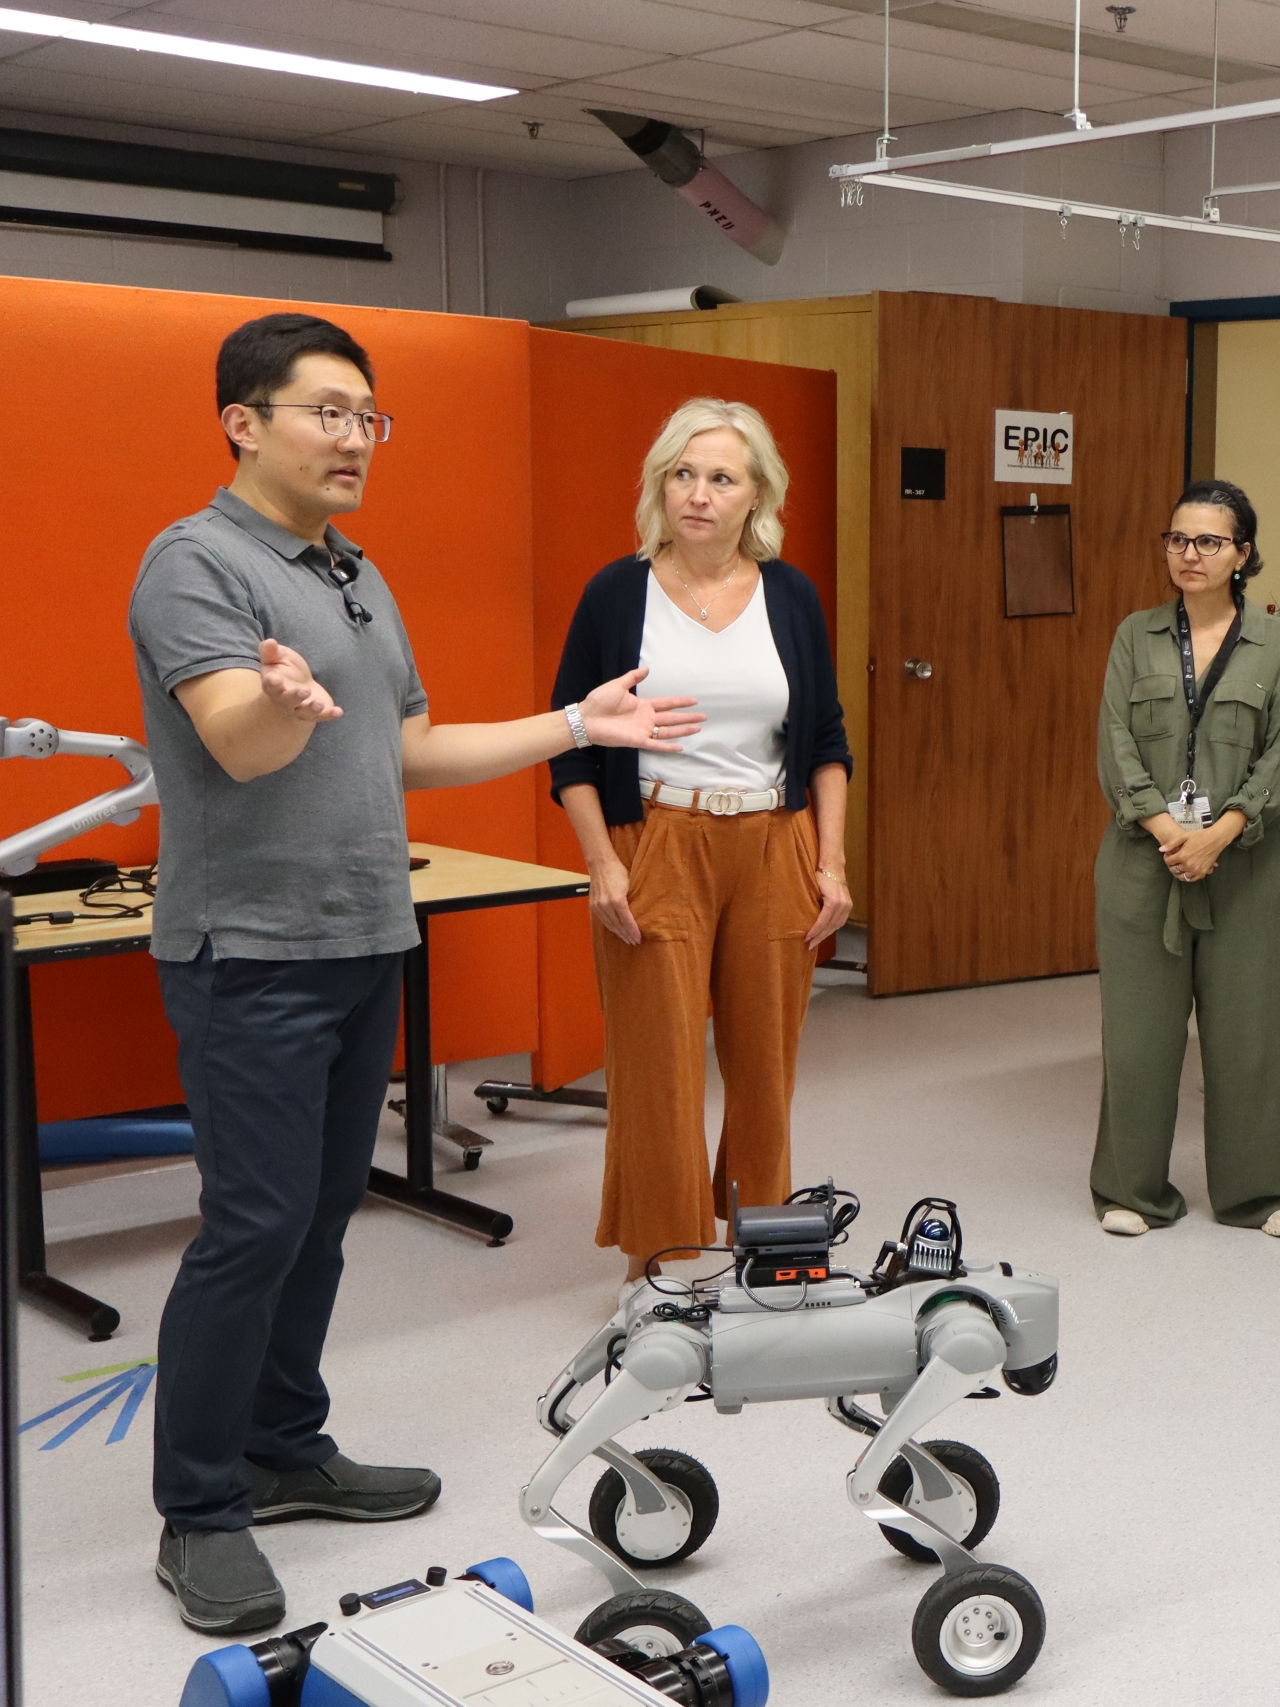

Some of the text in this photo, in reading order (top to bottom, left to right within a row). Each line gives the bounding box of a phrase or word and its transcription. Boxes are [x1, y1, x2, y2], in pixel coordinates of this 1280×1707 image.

[699, 201, 735, 230] PNEU
[1004, 425, 1069, 454] EPIC
[71, 804, 118, 831] Unitree
